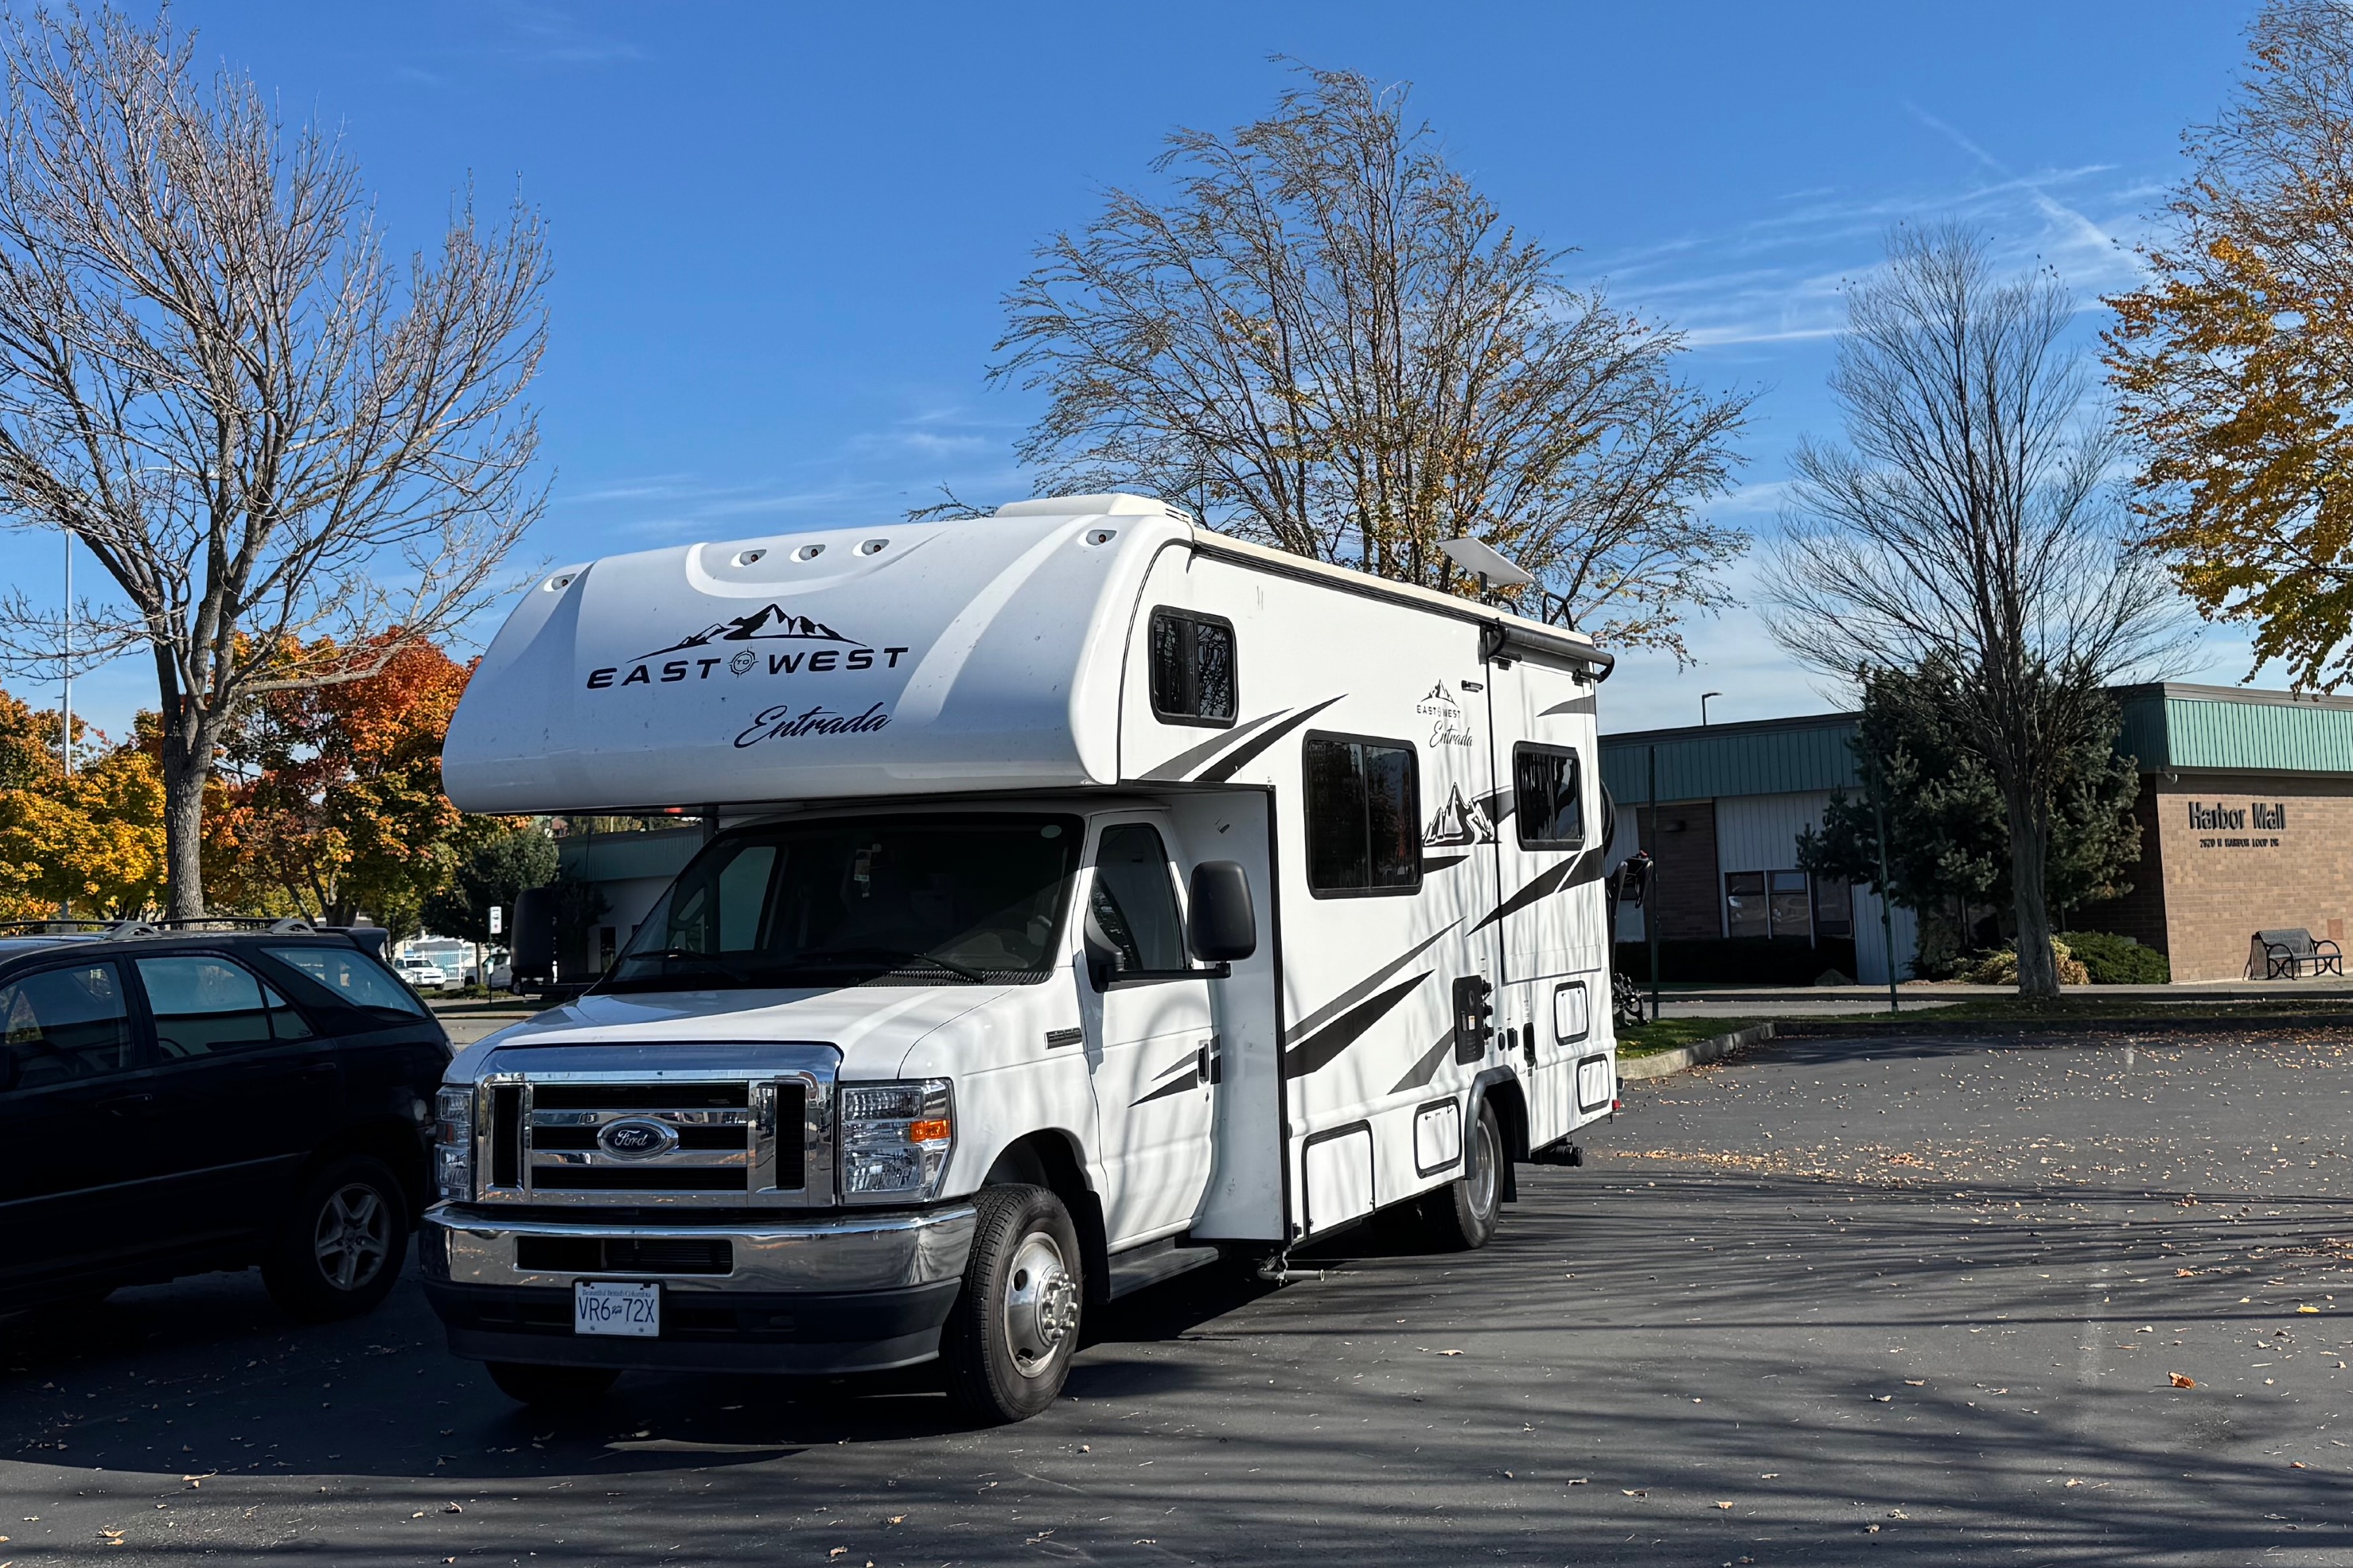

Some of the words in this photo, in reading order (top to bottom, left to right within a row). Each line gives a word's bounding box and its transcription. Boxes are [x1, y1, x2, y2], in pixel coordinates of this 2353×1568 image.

[587, 658, 721, 689] EAST
[769, 648, 909, 675] WEST
[734, 702, 892, 749] Entrada
[1416, 705, 1436, 715] EAST
[1443, 708, 1460, 718] WEST
[1429, 720, 1472, 748] Entrada
[2188, 802, 2246, 830] Harbor
[2252, 803, 2286, 830] Mall
[614, 1130, 649, 1146] Ford
[579, 1297, 610, 1321] VR6
[623, 1298, 655, 1323] 72X
